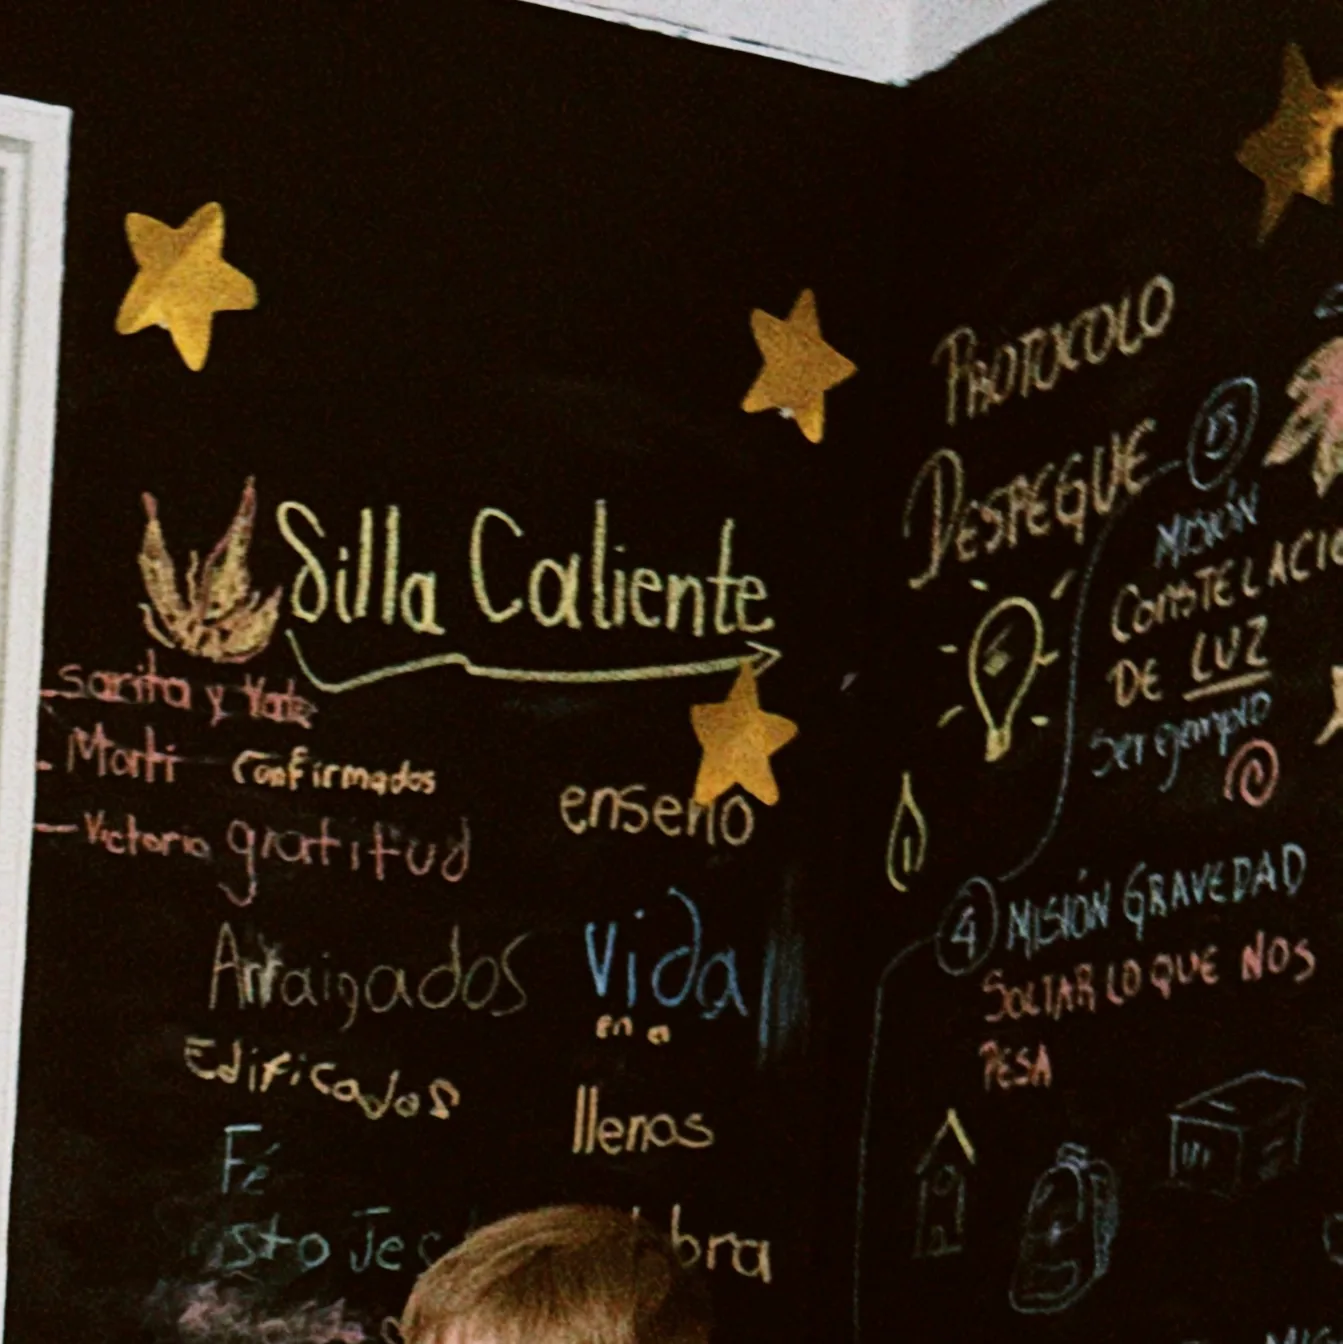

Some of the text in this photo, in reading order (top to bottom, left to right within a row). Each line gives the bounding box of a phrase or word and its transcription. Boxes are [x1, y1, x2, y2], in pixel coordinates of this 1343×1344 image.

[276, 499, 775, 637] Silla Caliente
[1105, 614, 1269, 708] DE LUZ
[232, 745, 436, 796] Confirmados
[218, 818, 471, 908] gratitud
[1123, 843, 1307, 940] GRAVEDAD
[982, 963, 1096, 1023] SOLTAR
[1150, 945, 1220, 1000] QUE
[1241, 930, 1316, 984] NOS
